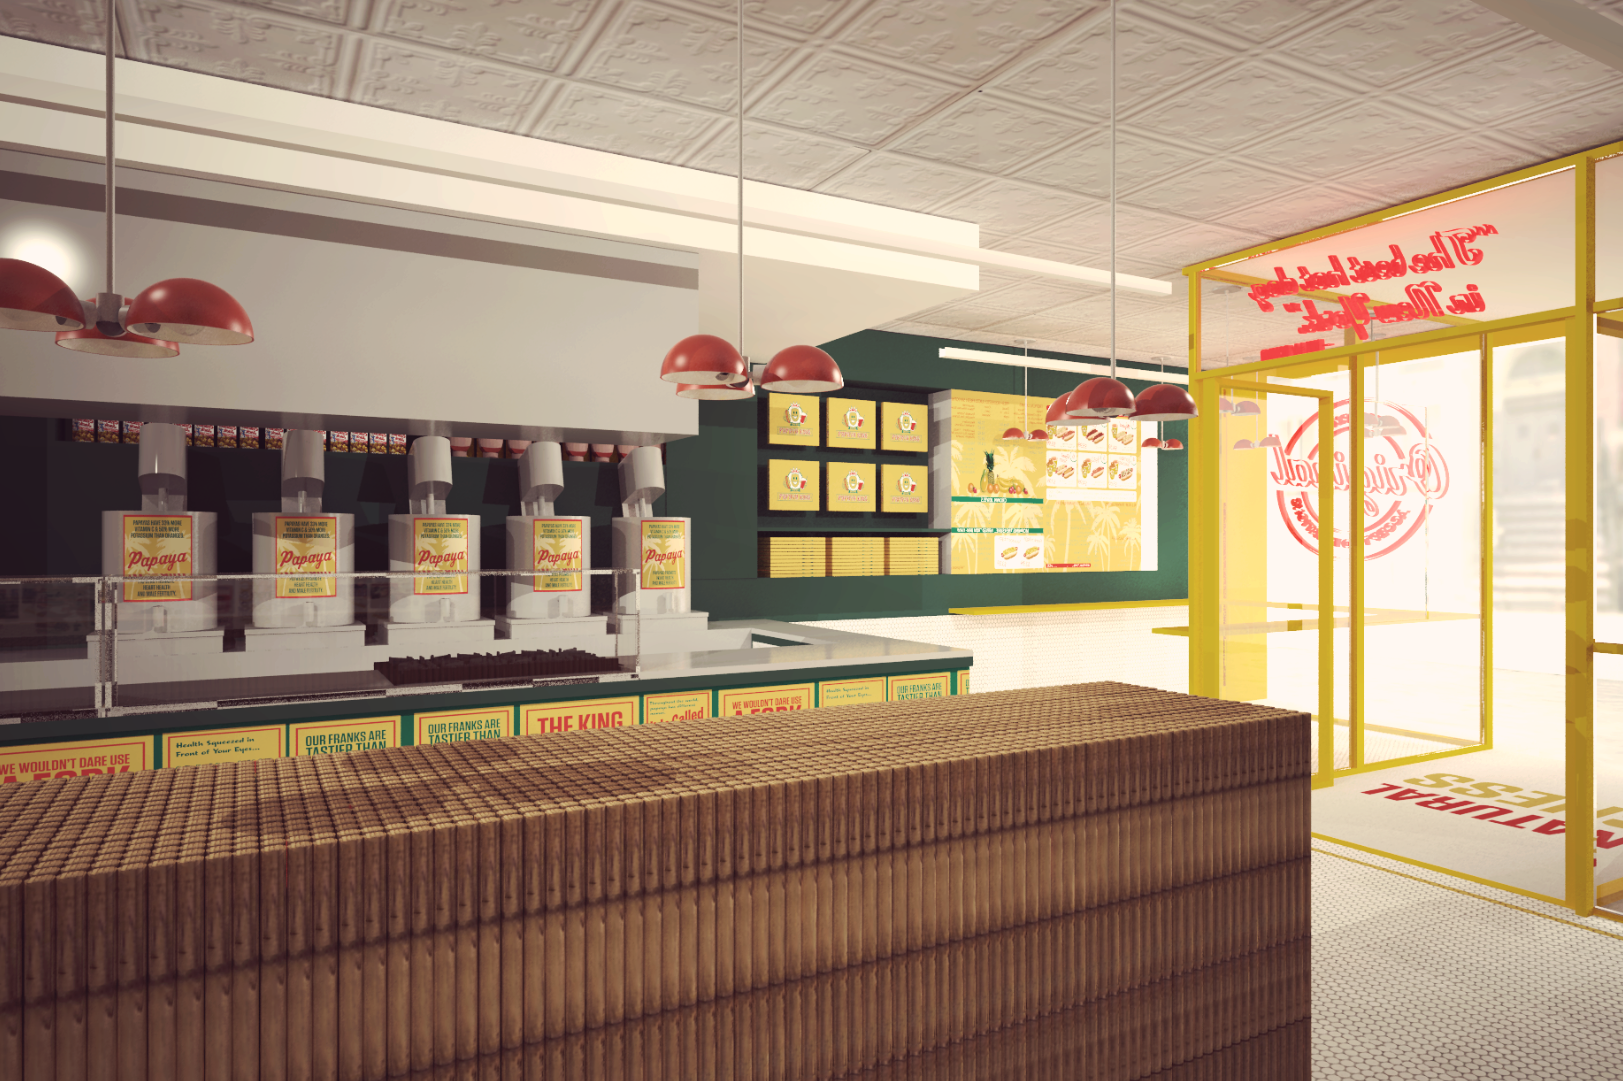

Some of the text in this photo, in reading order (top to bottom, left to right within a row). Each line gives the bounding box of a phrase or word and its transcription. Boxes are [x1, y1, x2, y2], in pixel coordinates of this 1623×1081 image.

[128, 551, 188, 571] Papaya
[280, 550, 332, 570] Papaya
[418, 550, 466, 568] Papaya
[537, 550, 579, 566] Papaya
[644, 549, 682, 566] Papaya
[896, 682, 942, 694] OUR FRANKS ARE
[897, 690, 942, 701] TASTIER THAN
[732, 696, 802, 710] WE WOULDN'T DARE USE
[428, 718, 500, 734] OUR FRANKS ARE
[537, 710, 623, 735] THE KING
[206, 737, 244, 747] Squeezed
[306, 730, 386, 746] OUR FRANKS ARE
[428, 728, 500, 744] TASTIER THAN
[306, 740, 386, 756] TASTIER THAN
[19, 758, 77, 774] WOULDN'T
[79, 756, 107, 768] DARE
[110, 754, 130, 765] USE
